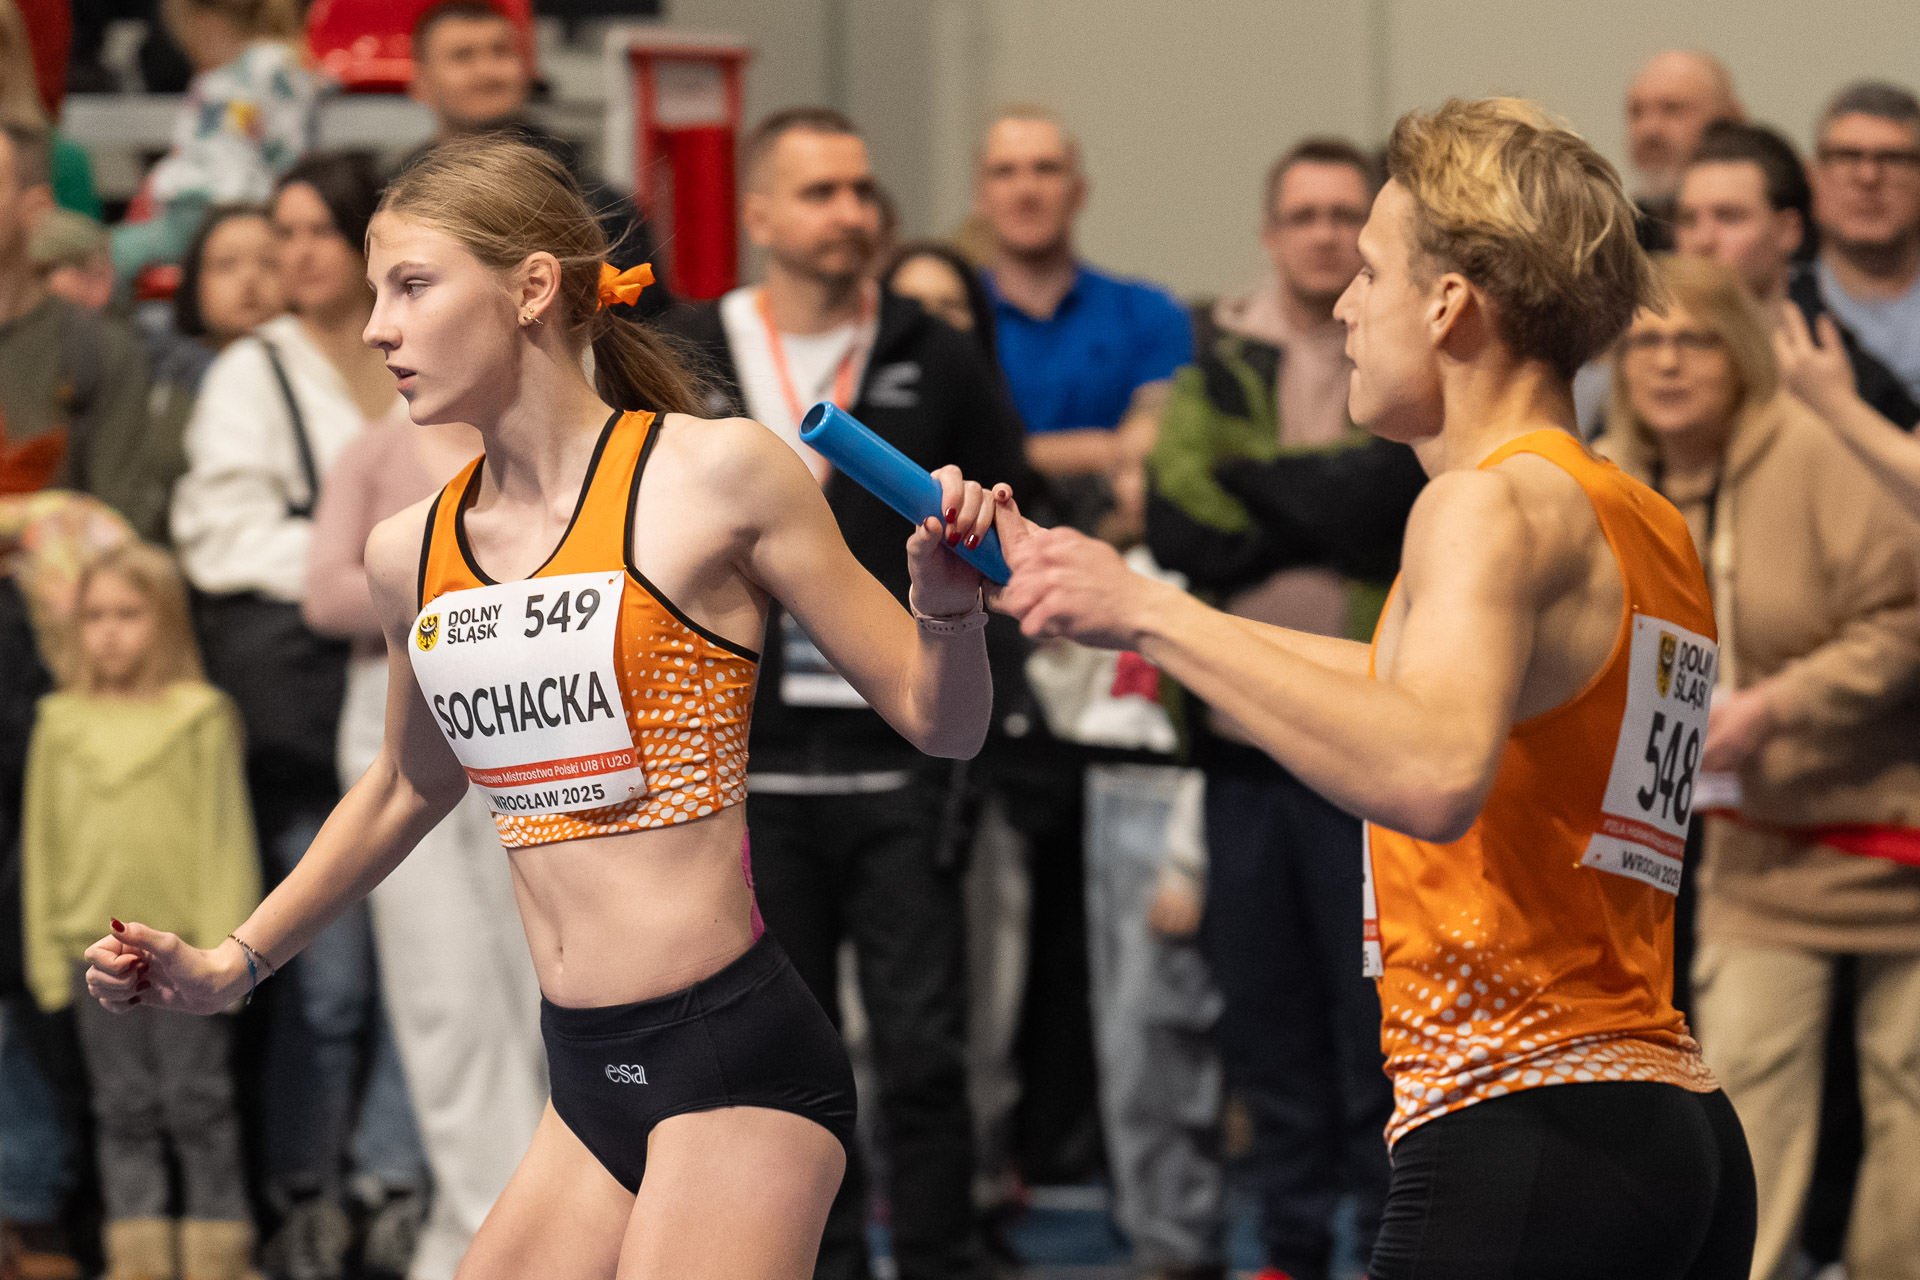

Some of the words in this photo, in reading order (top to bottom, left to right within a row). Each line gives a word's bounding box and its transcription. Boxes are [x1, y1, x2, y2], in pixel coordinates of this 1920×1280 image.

[448, 604, 502, 627] DOLNY
[523, 588, 601, 638] 549
[447, 622, 498, 645] ŚLĄSK
[433, 671, 615, 740] SOCHACKA
[502, 767, 554, 783] Mistrzostwa
[554, 764, 579, 776] Polski
[580, 759, 599, 772] U18
[600, 758, 606, 770] i
[607, 753, 631, 768] U20
[1637, 710, 1699, 826] 548
[491, 789, 559, 811] WROCŁAW
[562, 783, 606, 805] 2025
[604, 1064, 648, 1085] esa
